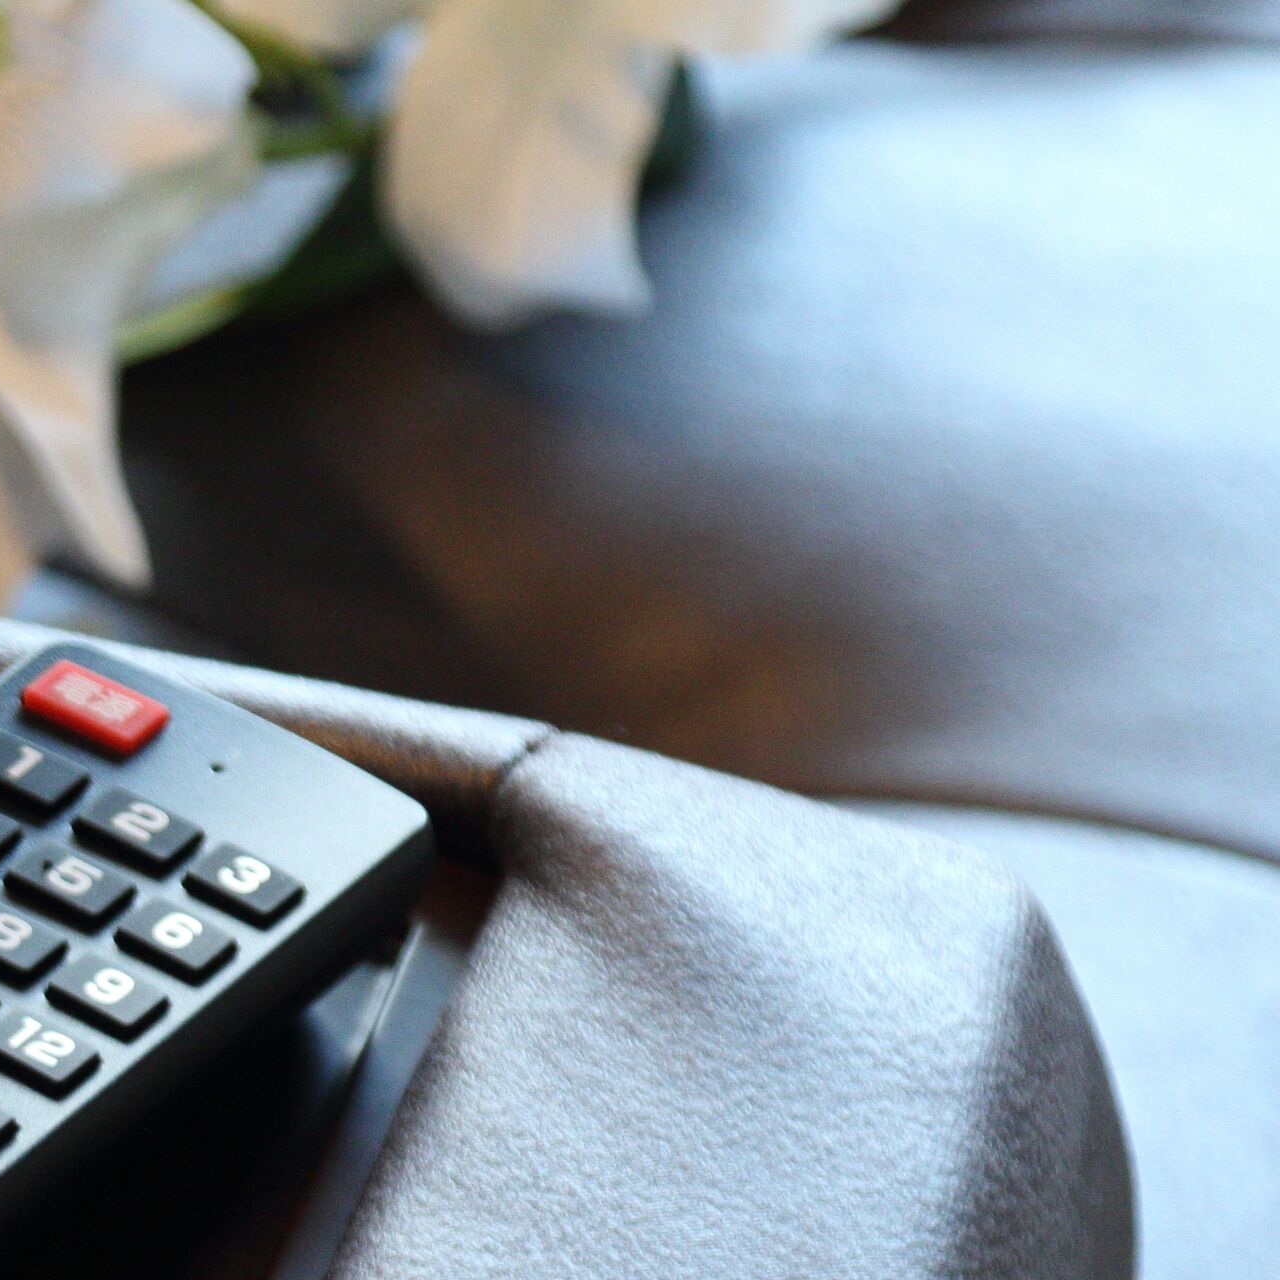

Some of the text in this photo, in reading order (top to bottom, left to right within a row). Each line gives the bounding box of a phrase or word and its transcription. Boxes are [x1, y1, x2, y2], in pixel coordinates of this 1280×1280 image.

[5, 746, 44, 778] 1
[112, 801, 170, 841] 2
[46, 857, 104, 893] 5
[218, 856, 272, 894] 3
[152, 912, 204, 949] 6
[84, 968, 135, 1004] 9
[6, 1017, 76, 1066] 12
